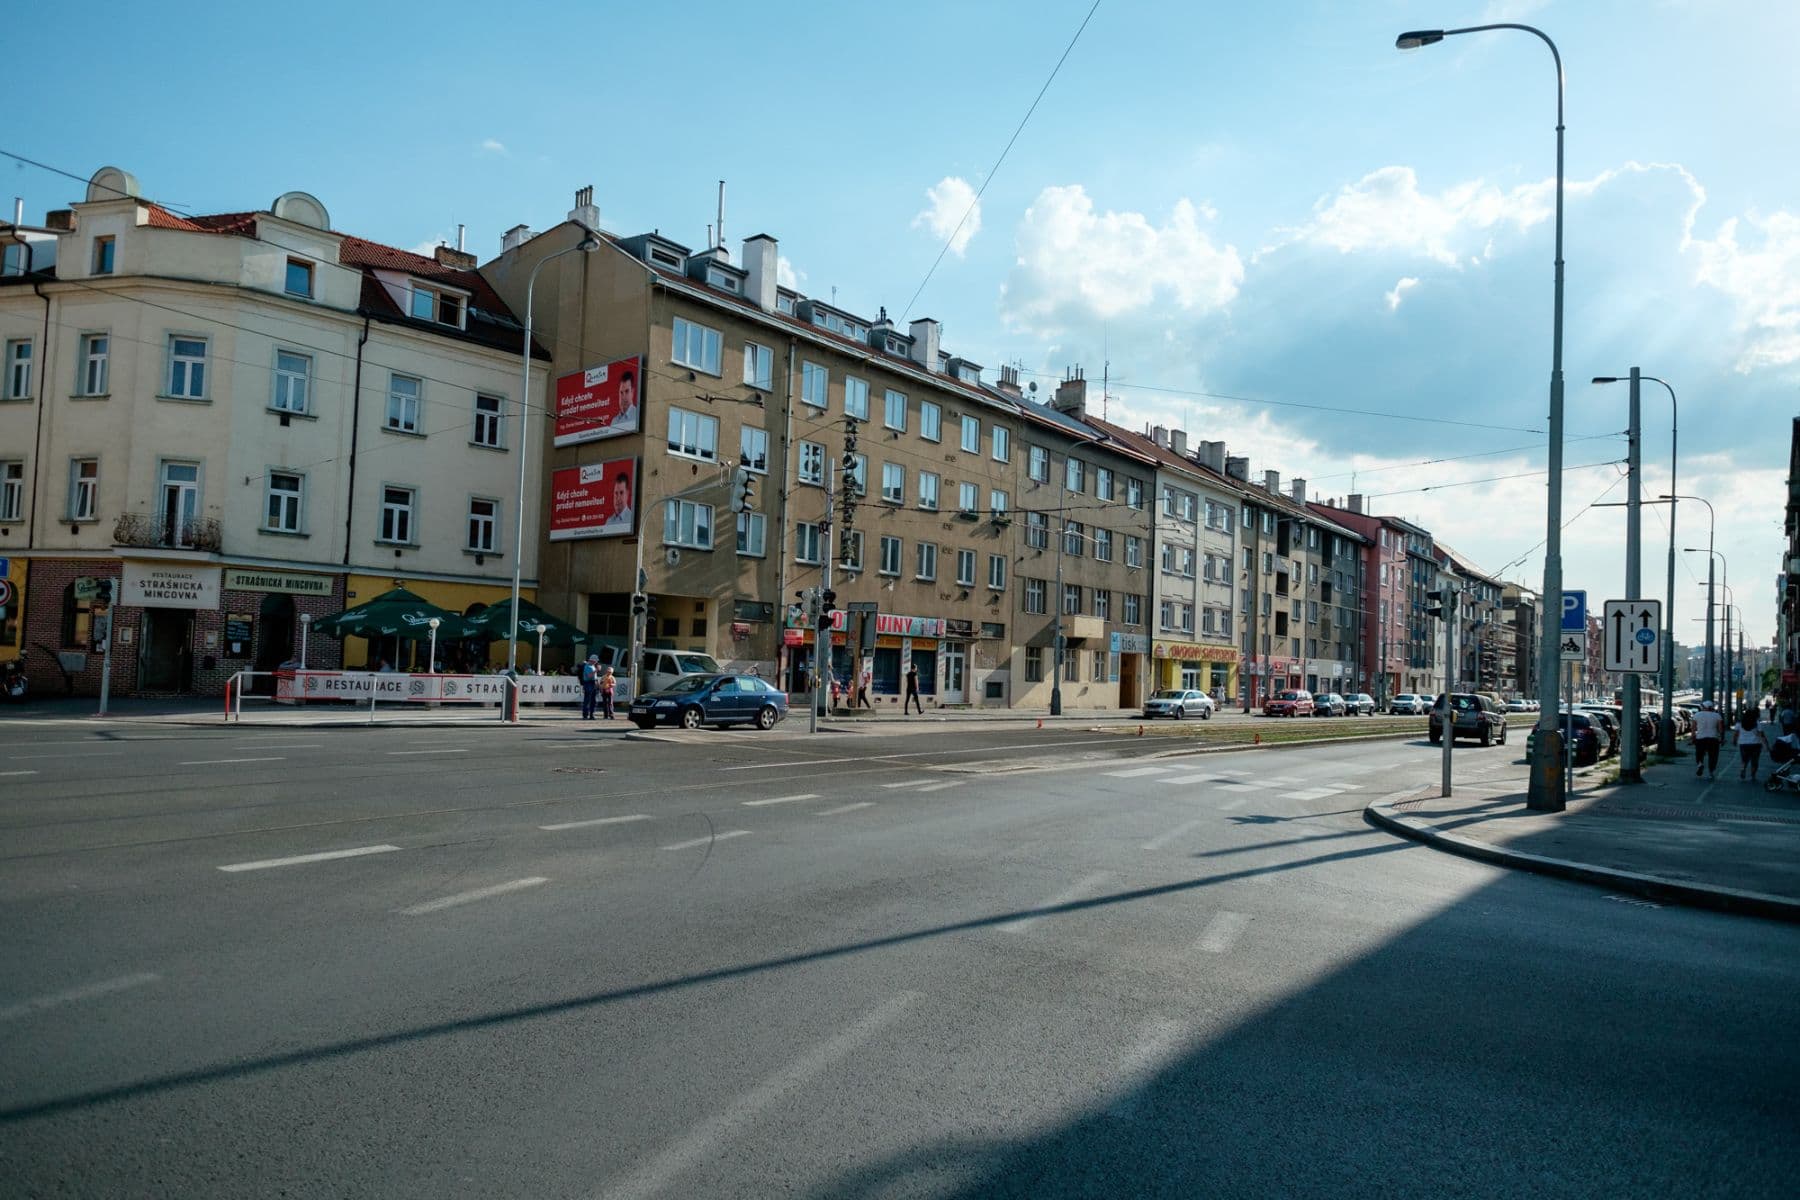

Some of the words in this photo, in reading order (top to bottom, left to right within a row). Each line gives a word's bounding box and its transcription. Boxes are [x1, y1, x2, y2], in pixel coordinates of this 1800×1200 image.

[285, 579, 323, 590] MINCOVNA
[144, 590, 198, 600] MINCOVNA
[1561, 595, 1579, 619] P
[1121, 635, 1136, 650] tisk
